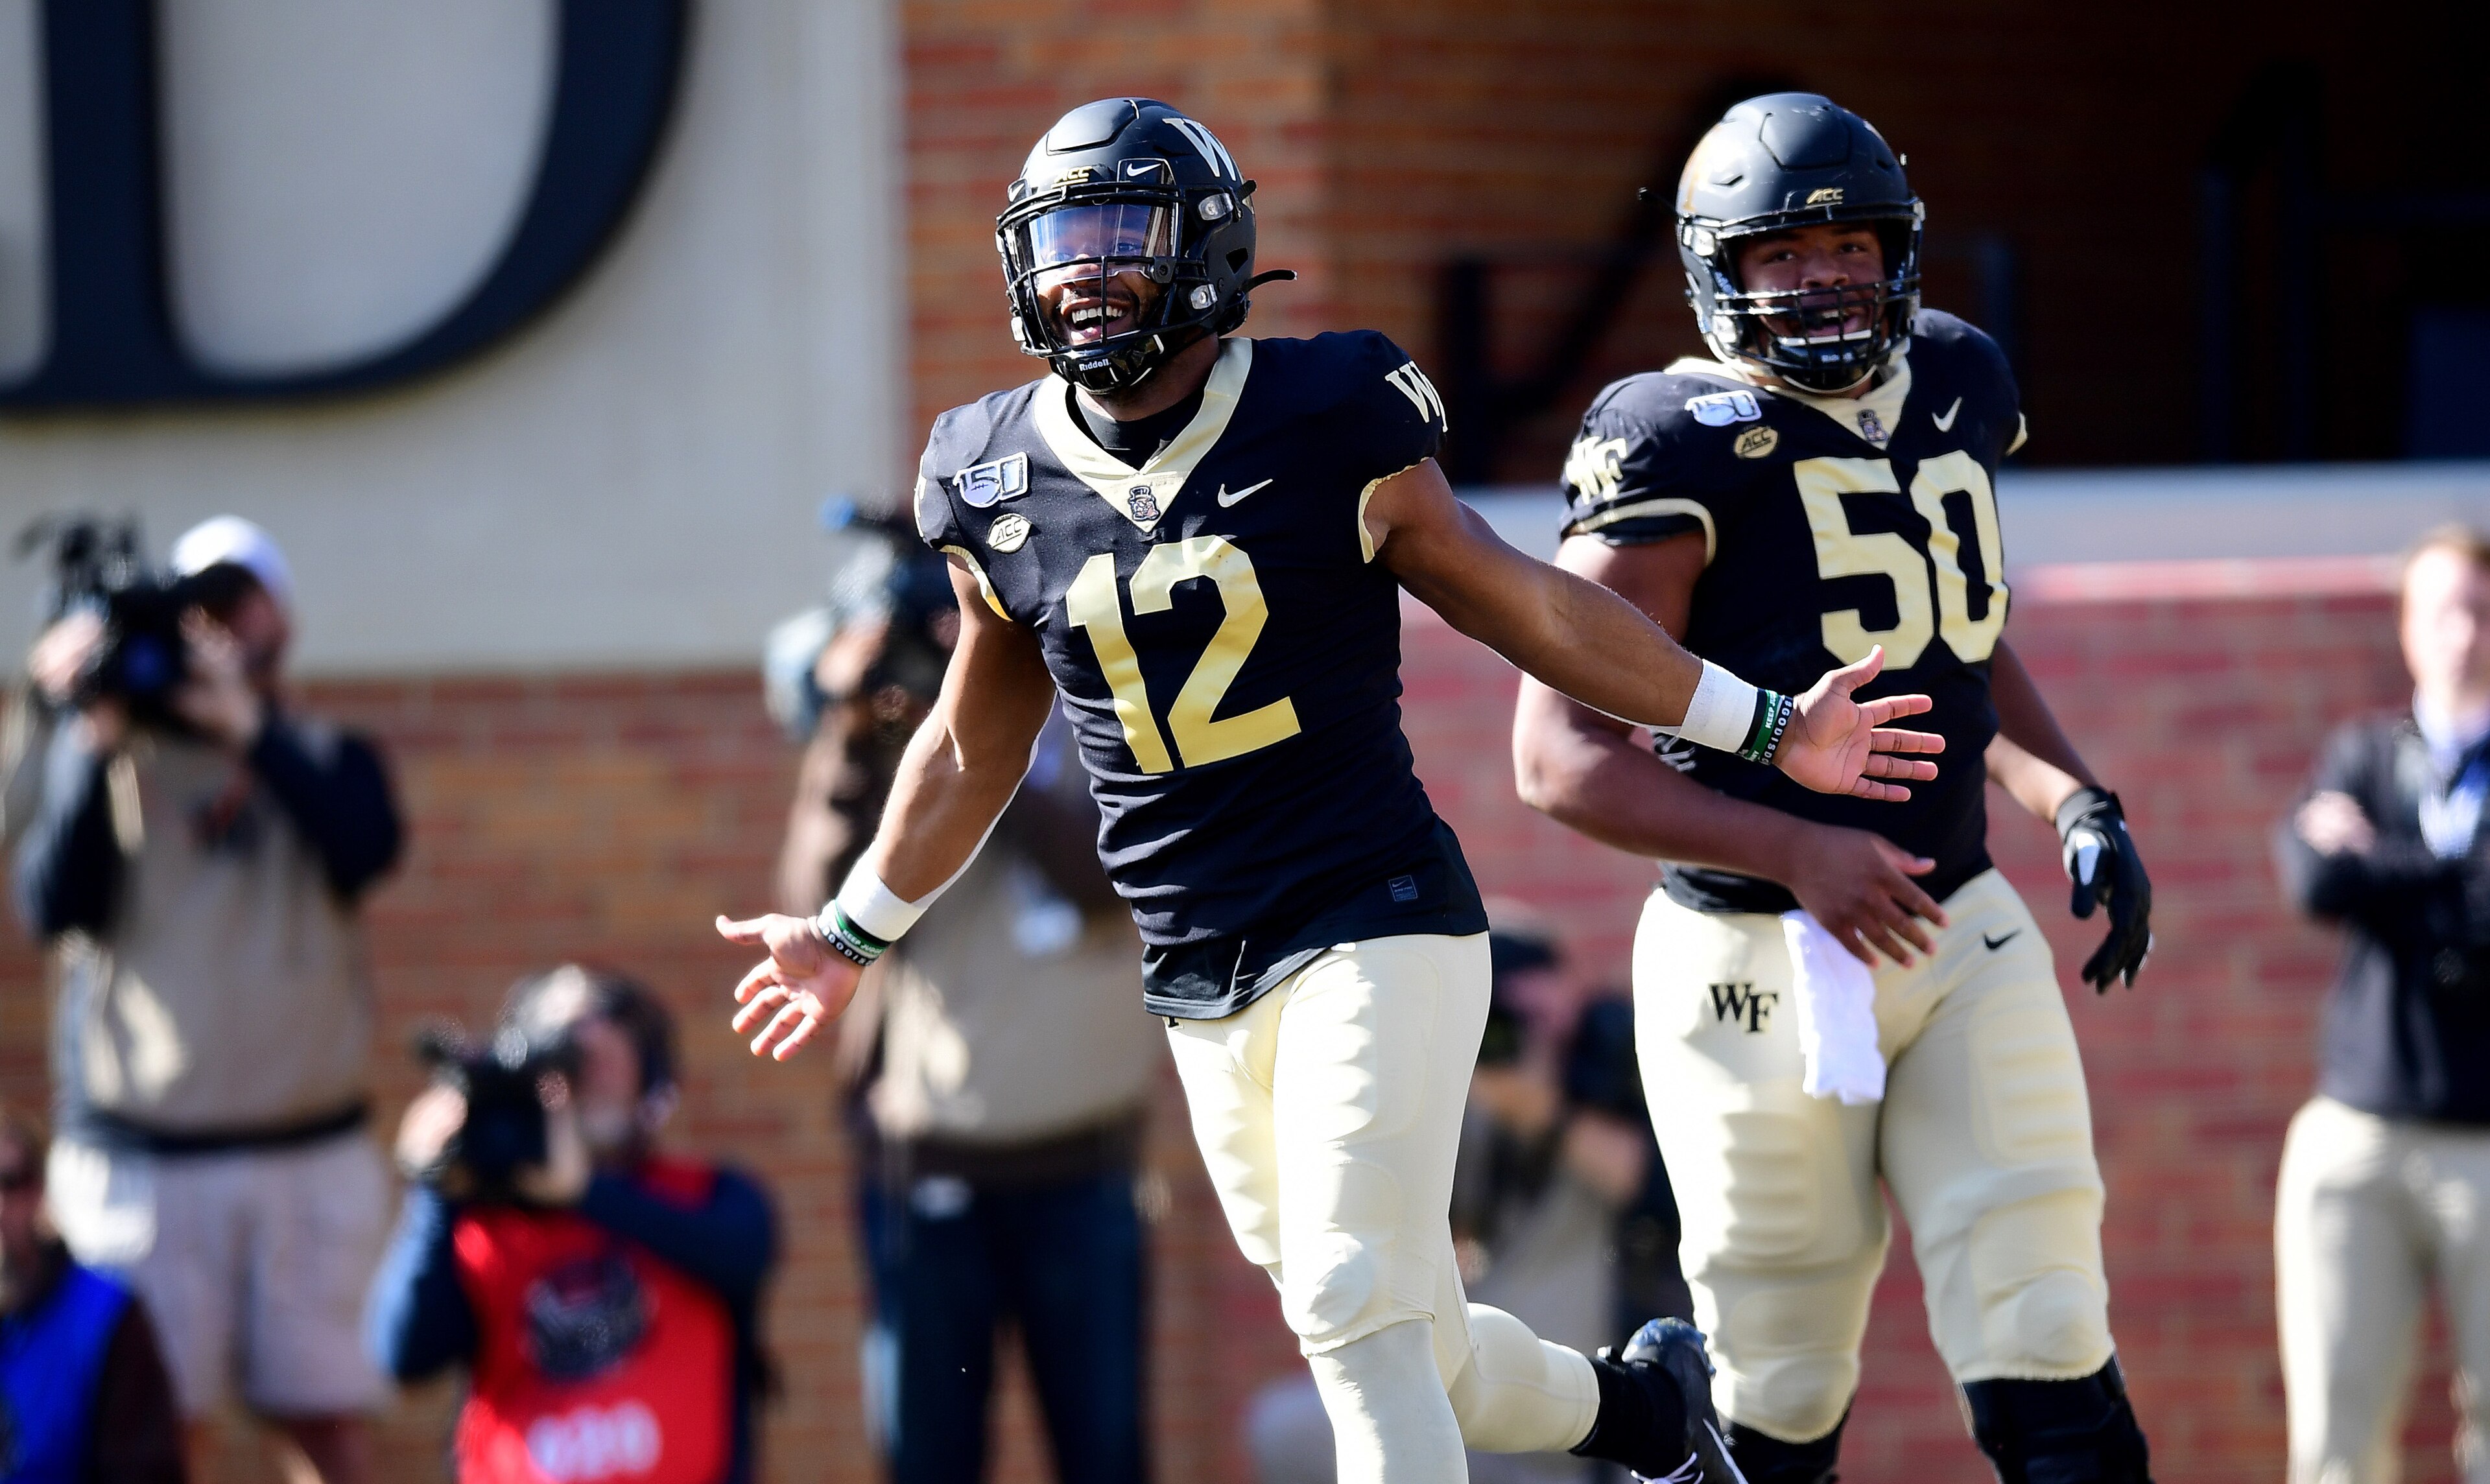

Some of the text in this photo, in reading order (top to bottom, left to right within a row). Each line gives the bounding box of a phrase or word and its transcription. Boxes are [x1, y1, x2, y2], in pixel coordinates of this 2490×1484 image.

[1053, 165, 1093, 183] ACC
[1806, 188, 1844, 204] ACC
[1740, 430, 1771, 452] ACC
[958, 454, 1026, 505] 150
[995, 519, 1023, 543] ACC
[1793, 449, 2008, 670] 50
[1066, 535, 1301, 774] 12
[1764, 706, 1775, 729] KEEP
[843, 928, 862, 946] KEEP
[1708, 982, 1778, 1033] WF
